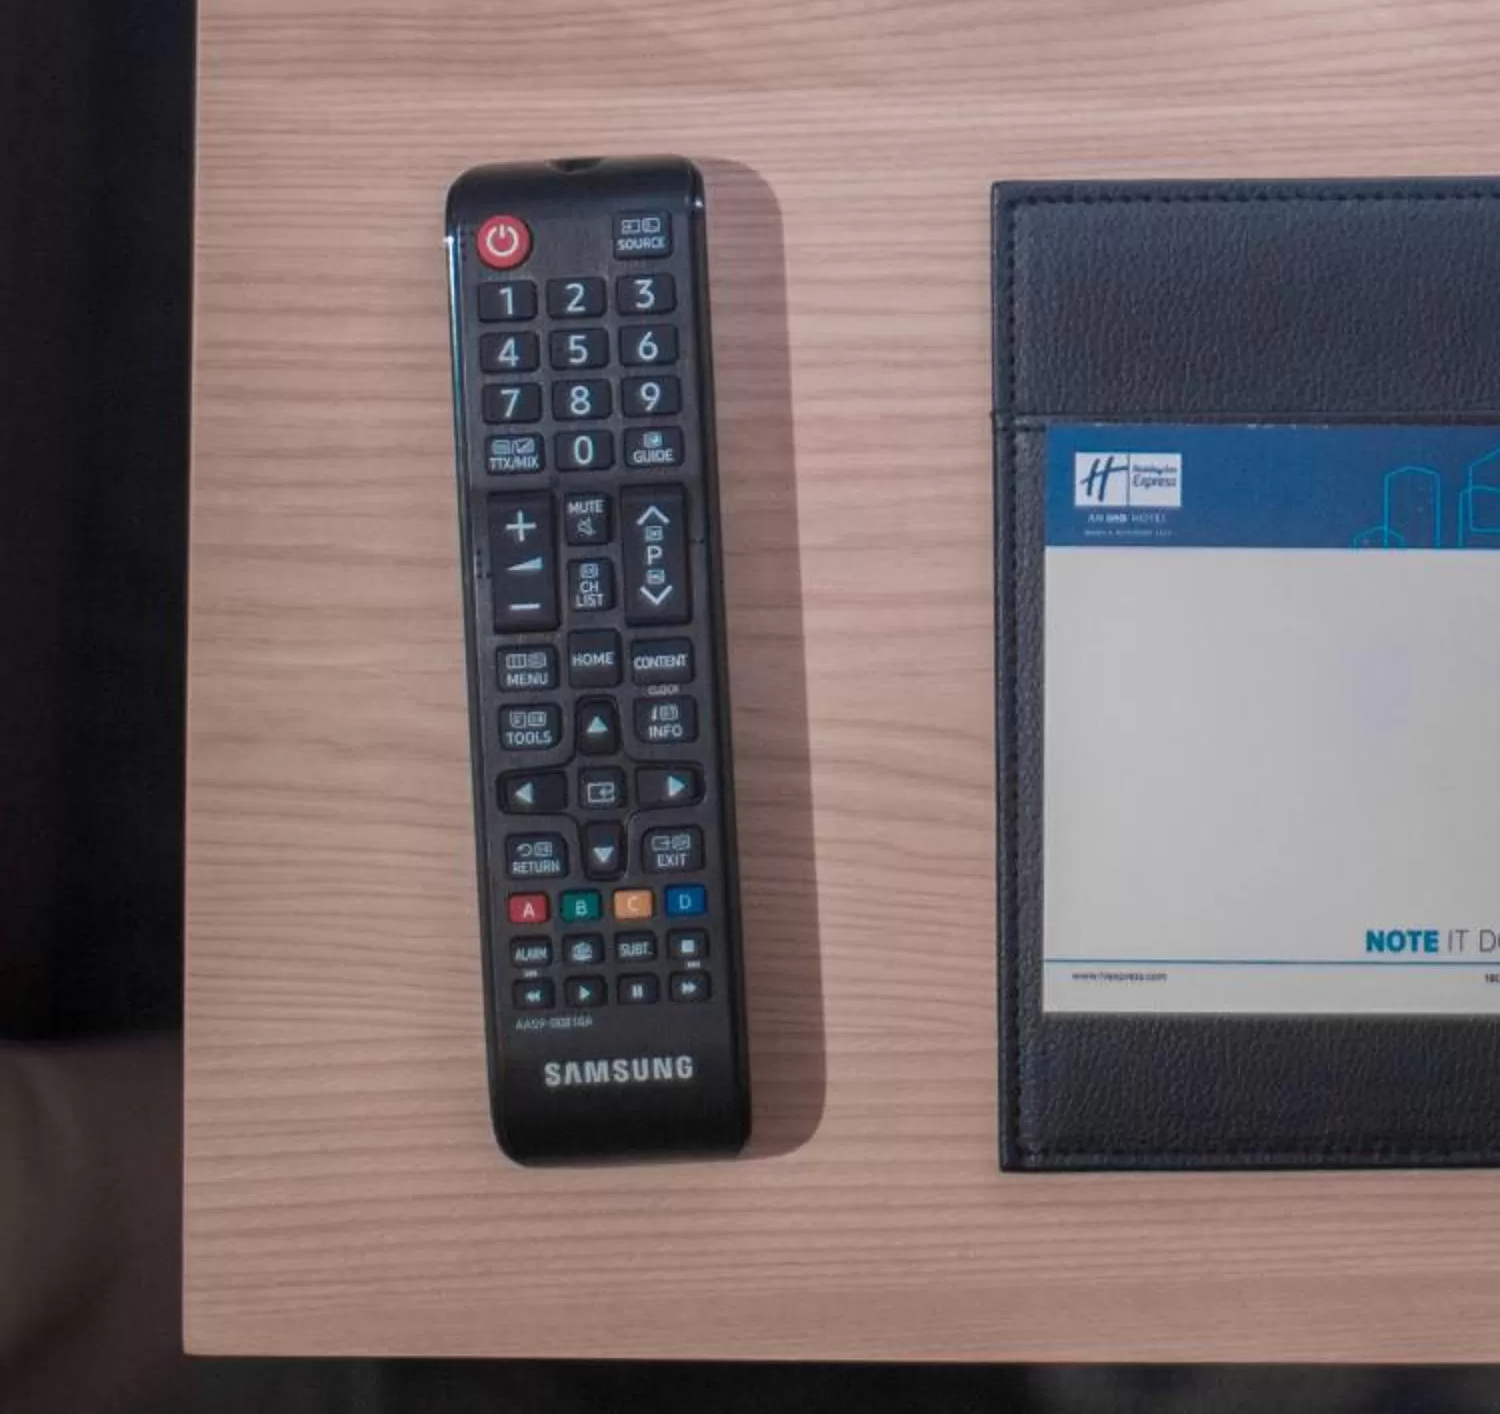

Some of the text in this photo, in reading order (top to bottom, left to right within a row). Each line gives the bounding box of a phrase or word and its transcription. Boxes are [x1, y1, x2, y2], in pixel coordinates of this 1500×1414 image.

[616, 237, 665, 250] SOURCE
[565, 283, 585, 314] 2
[634, 279, 655, 308] 3
[500, 288, 513, 315] 1
[498, 338, 519, 367] 4
[568, 335, 588, 364] 5
[638, 331, 659, 360] 6
[501, 389, 520, 418] 7
[570, 385, 591, 415] 8
[640, 382, 660, 411] 9
[573, 436, 593, 465] 0
[633, 449, 674, 463] GUIDE
[567, 499, 604, 514] MUTE
[647, 546, 662, 565] P
[579, 581, 599, 593] CH
[575, 594, 605, 608] LIST
[571, 652, 614, 666] HOME
[633, 655, 688, 669] CONTENT
[507, 673, 549, 686] MENU
[506, 731, 552, 745] TOOLS
[648, 724, 682, 738] INFO
[512, 860, 560, 875] RETURN
[657, 853, 687, 867] EXIT
[575, 901, 587, 916] B
[626, 897, 639, 911] C
[679, 894, 692, 909] D
[523, 902, 535, 917] A
[1365, 929, 1439, 953] NOTE
[1447, 929, 1469, 952] IT
[544, 1056, 693, 1087] SAMSUNG
